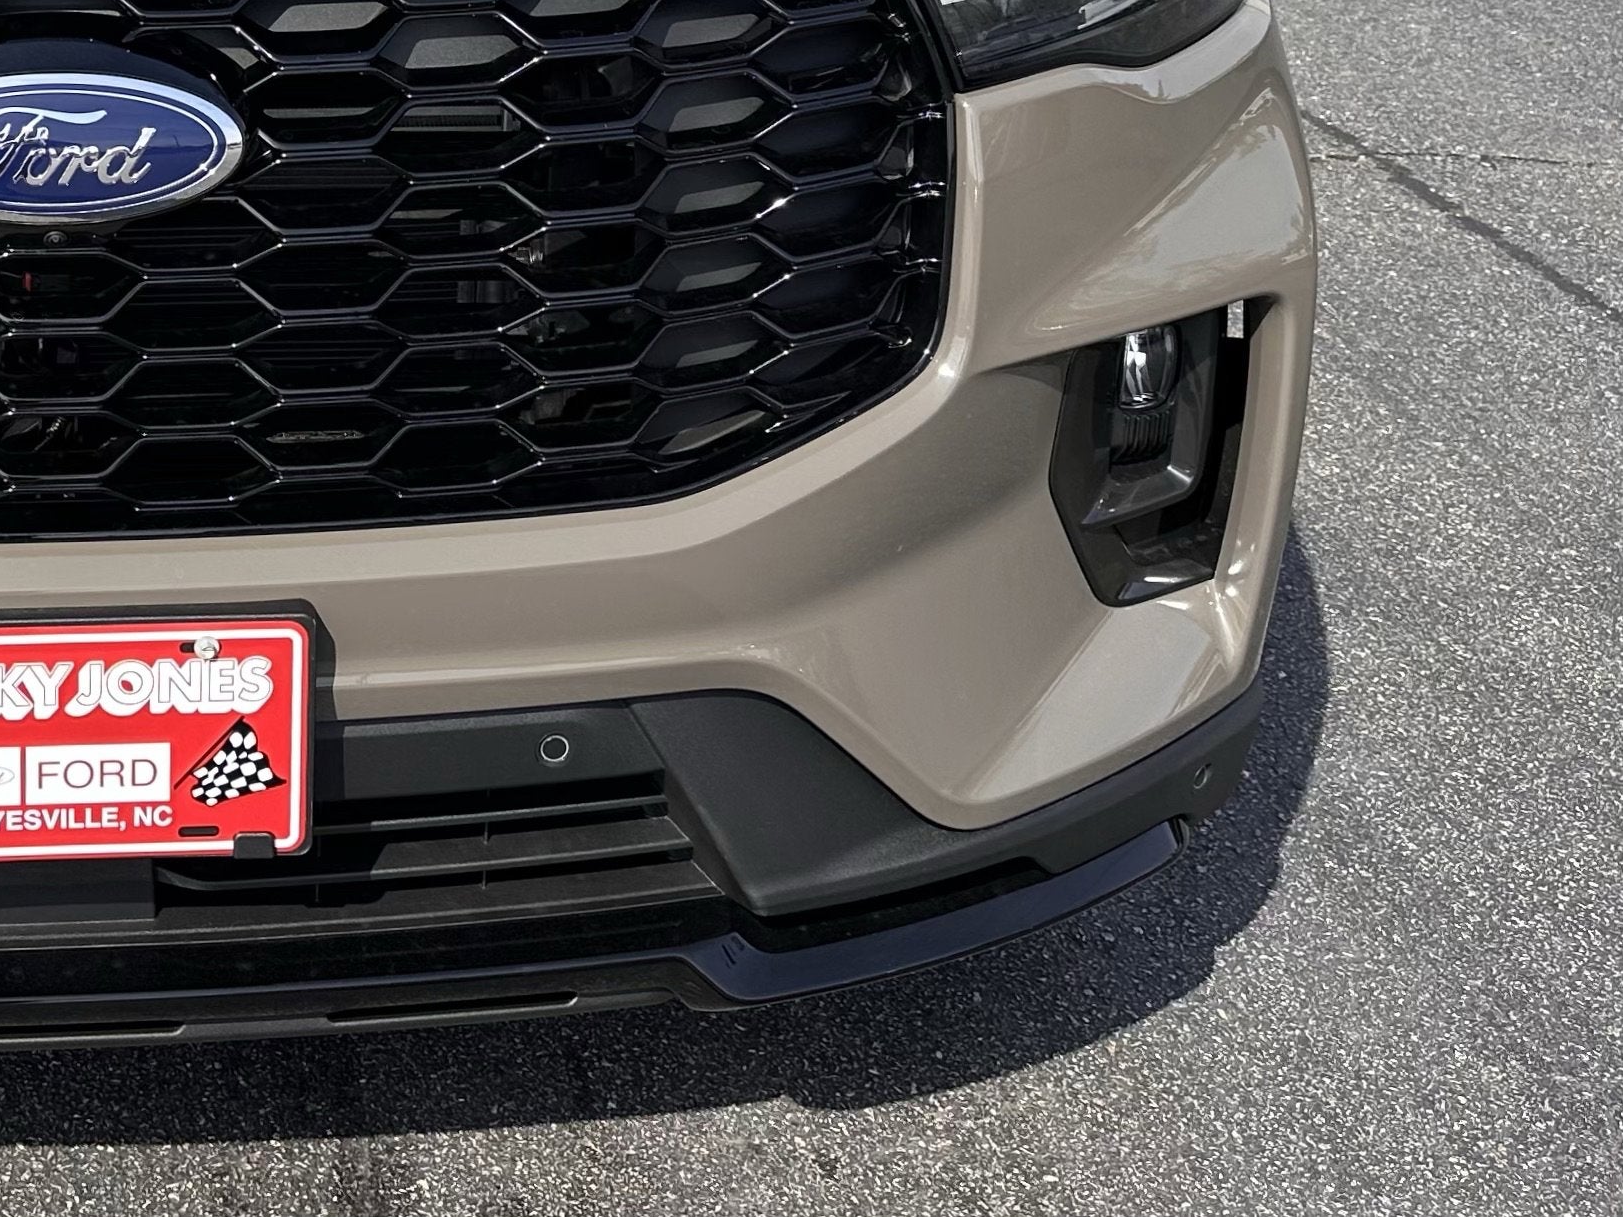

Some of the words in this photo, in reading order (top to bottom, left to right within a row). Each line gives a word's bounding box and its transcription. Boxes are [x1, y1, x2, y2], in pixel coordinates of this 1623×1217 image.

[64, 655, 274, 717] JONES
[38, 759, 158, 790] FORD
[134, 804, 174, 828] NC
